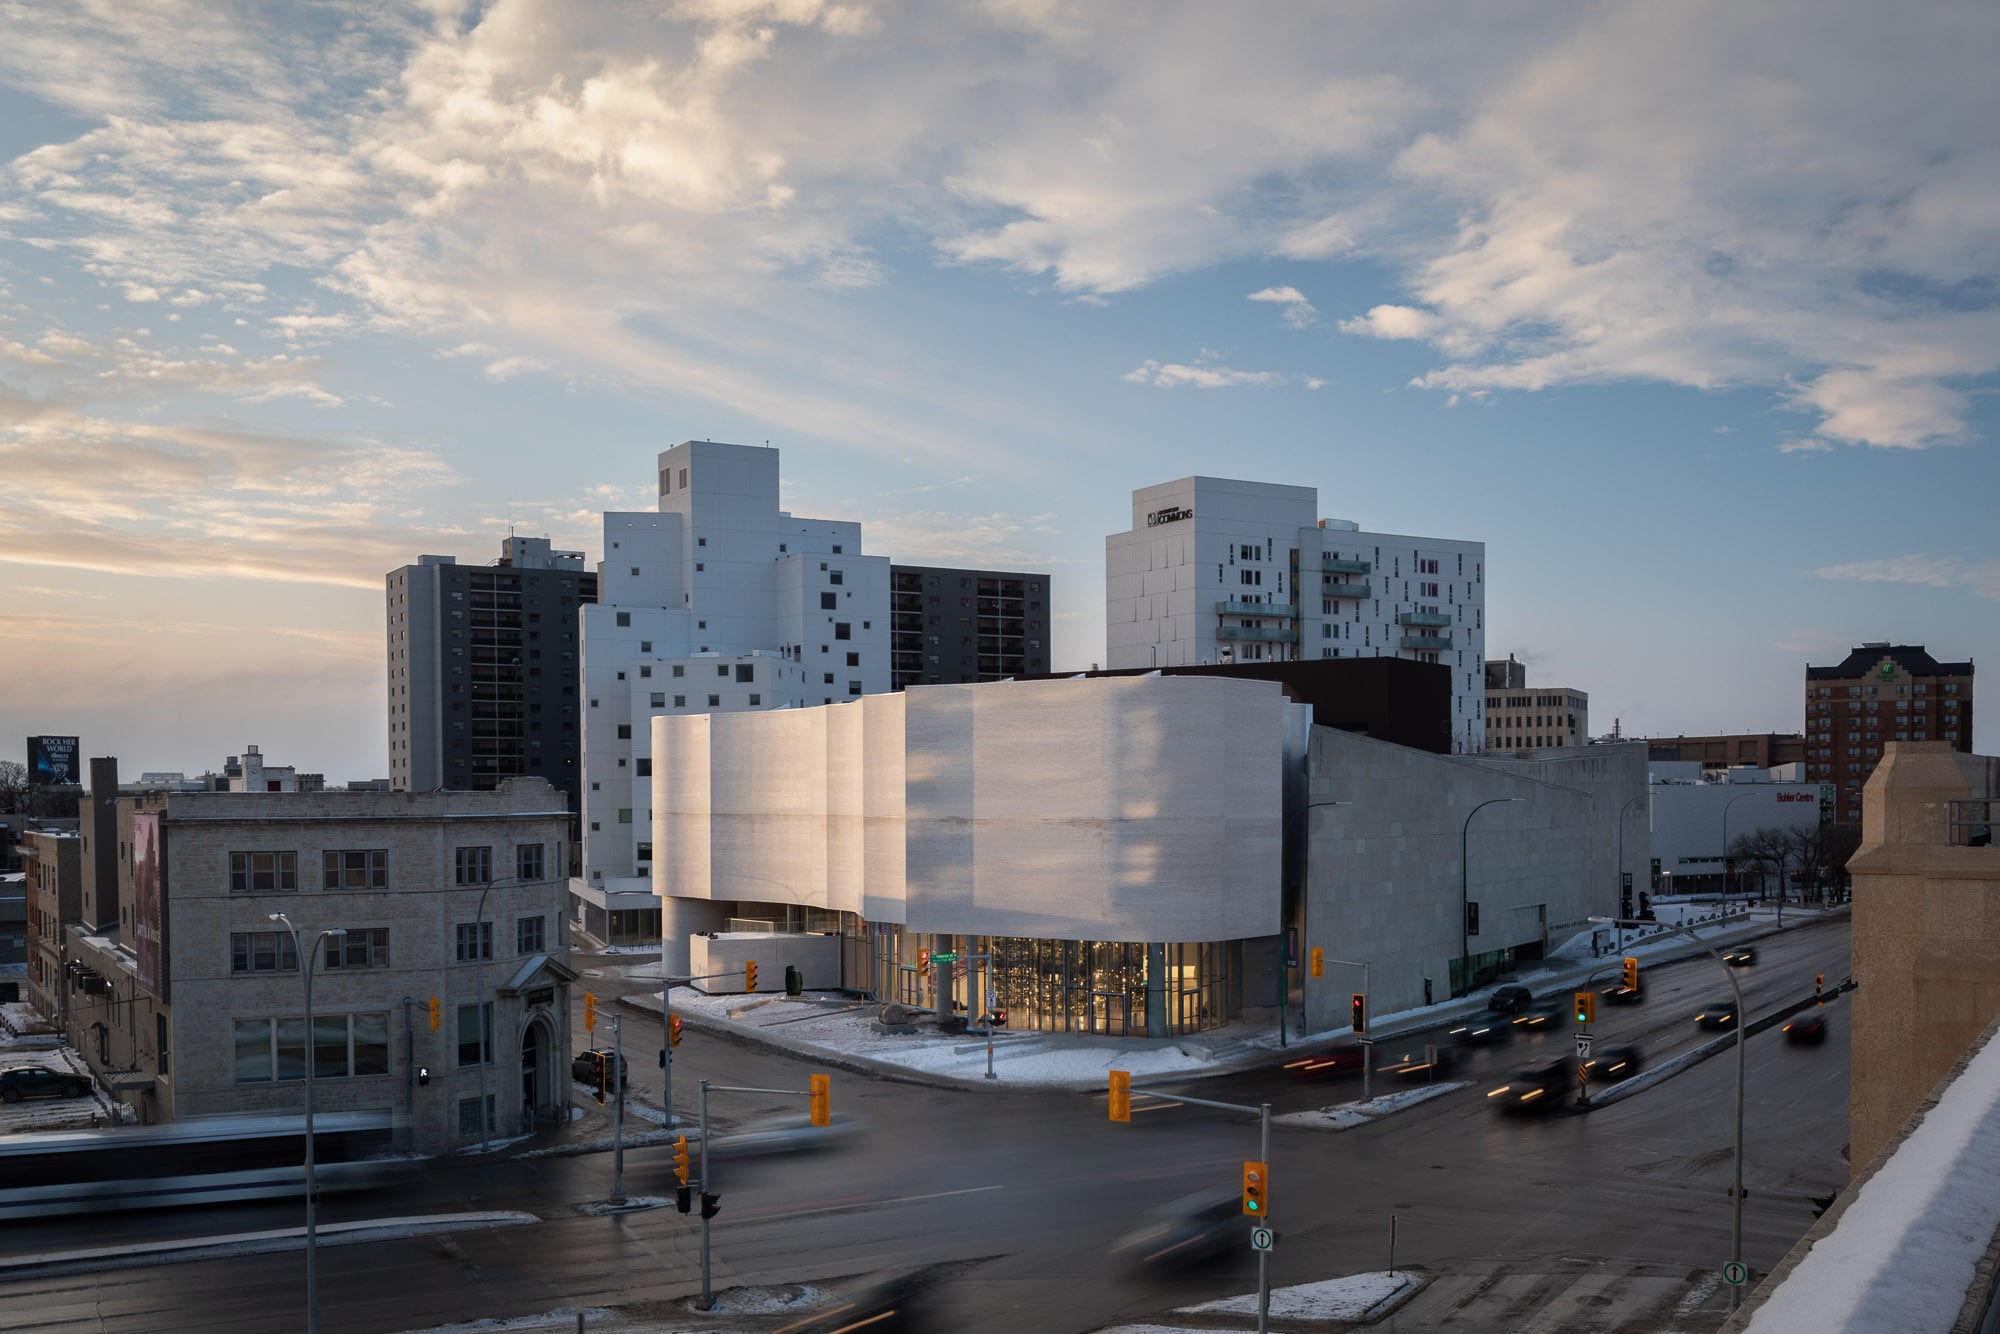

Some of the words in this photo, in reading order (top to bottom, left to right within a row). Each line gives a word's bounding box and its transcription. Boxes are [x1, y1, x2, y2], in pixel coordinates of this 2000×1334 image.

[1159, 509, 1192, 525] COMMONS
[62, 738, 76, 746] HER
[46, 745, 72, 753] WORLD
[1776, 792, 1795, 802] Buhler
[1796, 792, 1814, 802] Centre
